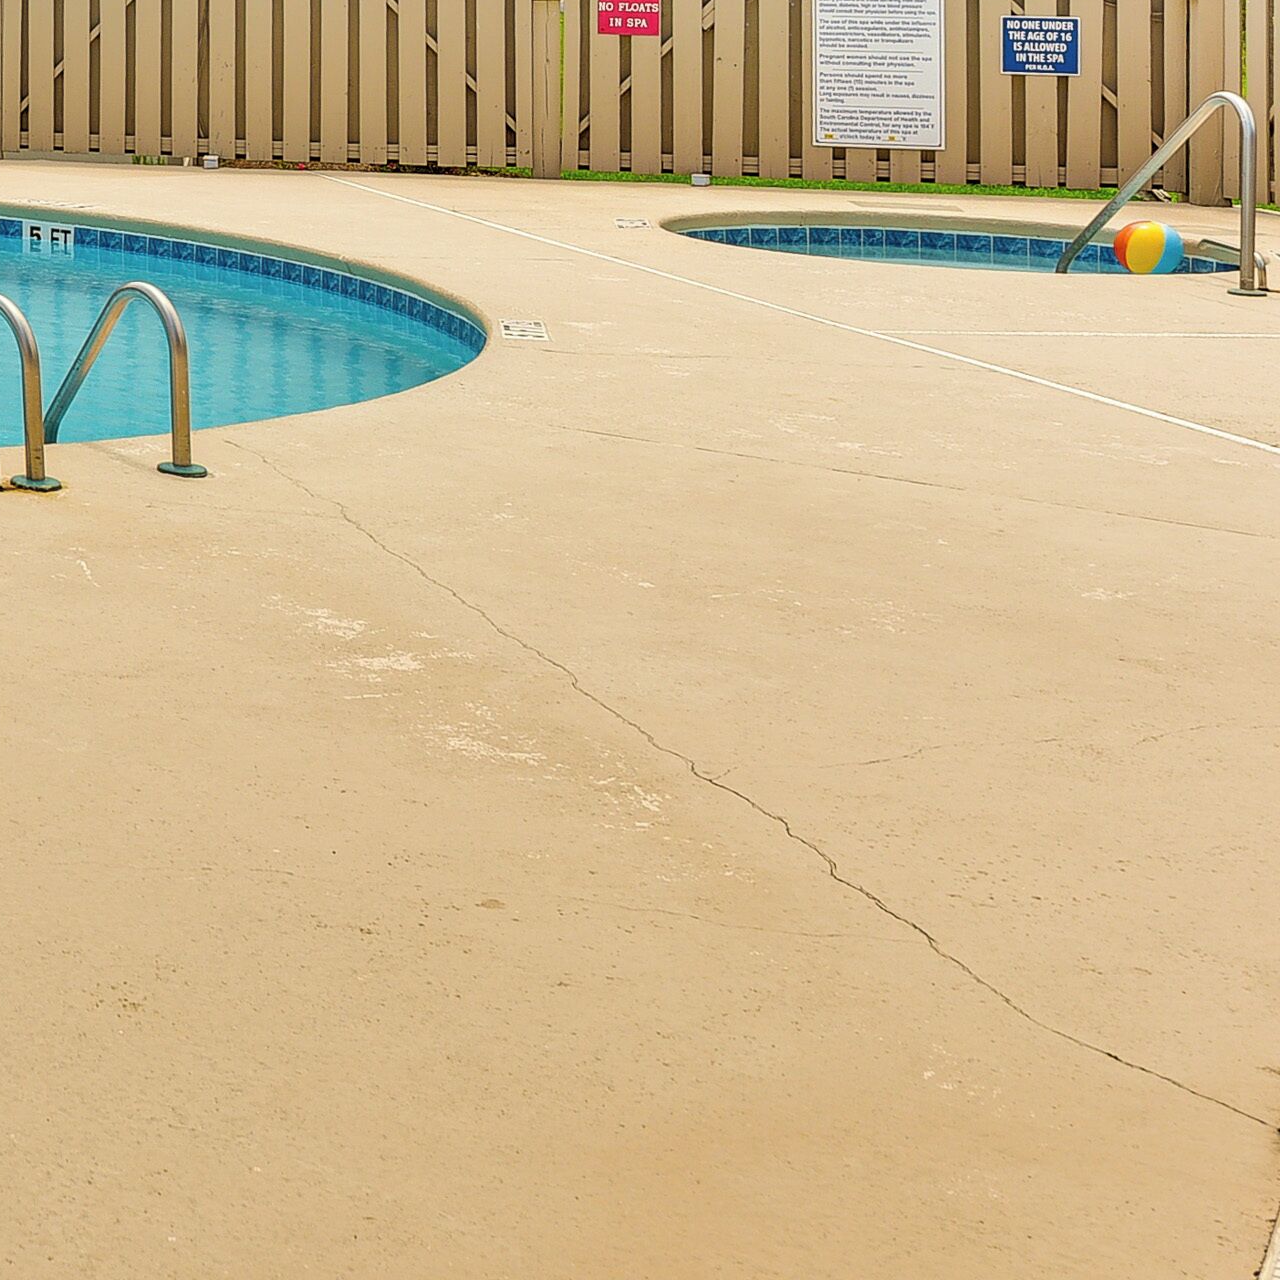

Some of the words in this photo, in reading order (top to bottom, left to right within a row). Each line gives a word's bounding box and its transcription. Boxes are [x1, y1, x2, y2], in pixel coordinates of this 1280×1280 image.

[599, 2, 613, 11] NO
[619, 3, 659, 12] FLOATS
[609, 18, 622, 27] IN
[627, 18, 648, 28] SPA
[1007, 20, 1020, 29] NO
[1022, 20, 1040, 30] ONE
[1042, 21, 1074, 30] UNDER
[1008, 31, 1026, 40] THE
[1027, 32, 1045, 41] AGE
[1046, 32, 1059, 41] OF
[1060, 32, 1072, 41] 16
[1013, 42, 1022, 51] IS
[1024, 42, 1067, 52] ALLOWED
[1016, 53, 1026, 62] IN
[1027, 53, 1045, 63] THE
[1046, 54, 1064, 63] SPA
[30, 226, 42, 243] 5
[51, 228, 72, 246] FT
